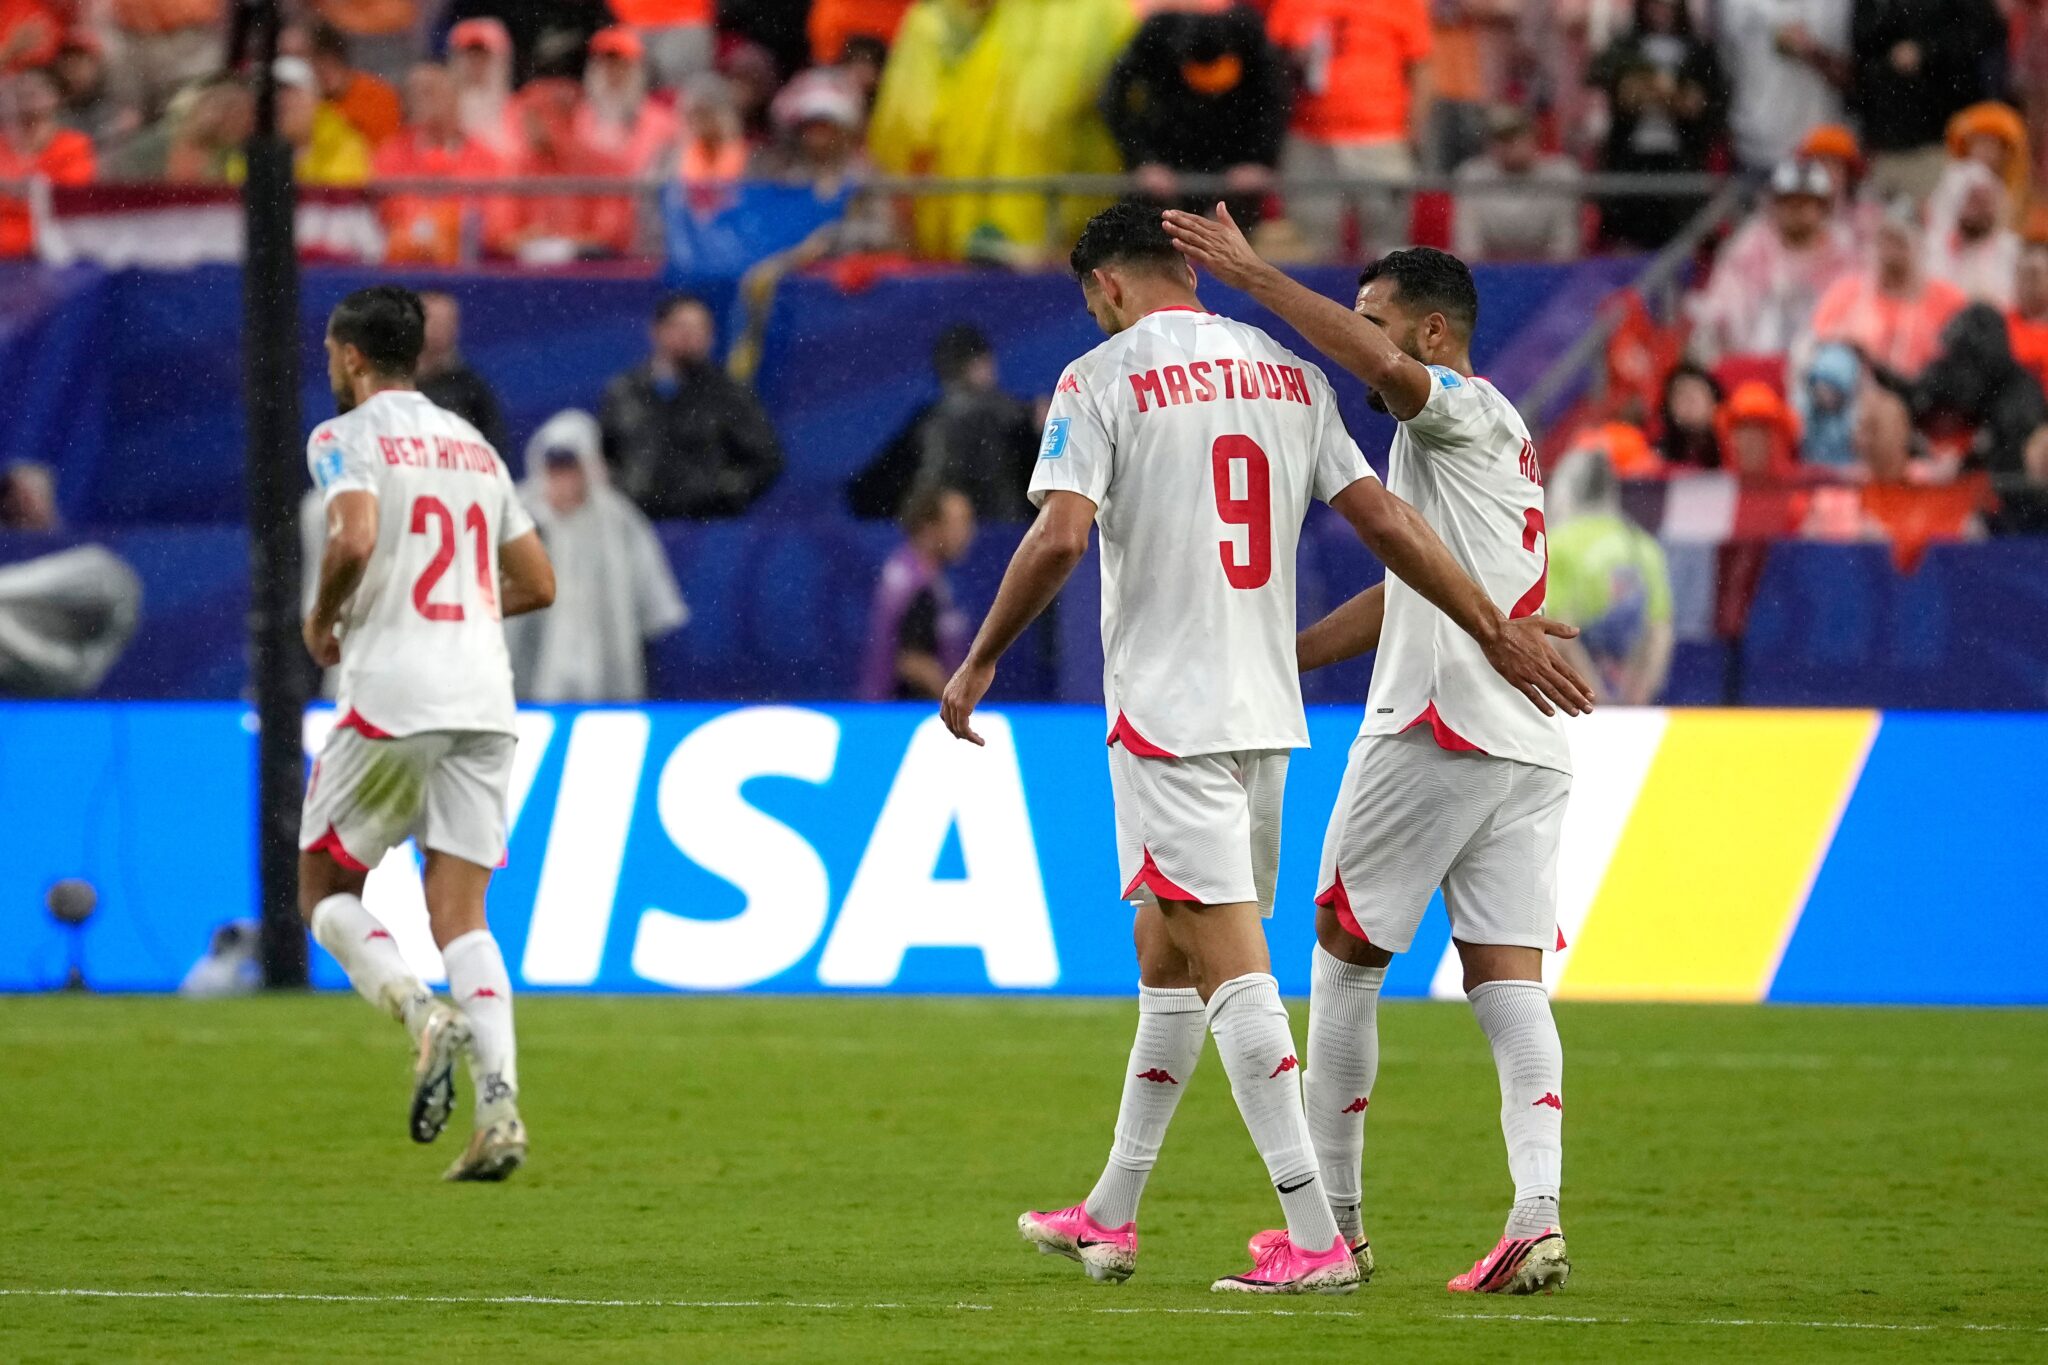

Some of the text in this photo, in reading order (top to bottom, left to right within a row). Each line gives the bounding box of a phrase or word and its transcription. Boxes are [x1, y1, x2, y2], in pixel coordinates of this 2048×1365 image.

[1128, 358, 1312, 413] MASTOURI
[410, 495, 500, 622] 21
[1212, 434, 1272, 590] 9
